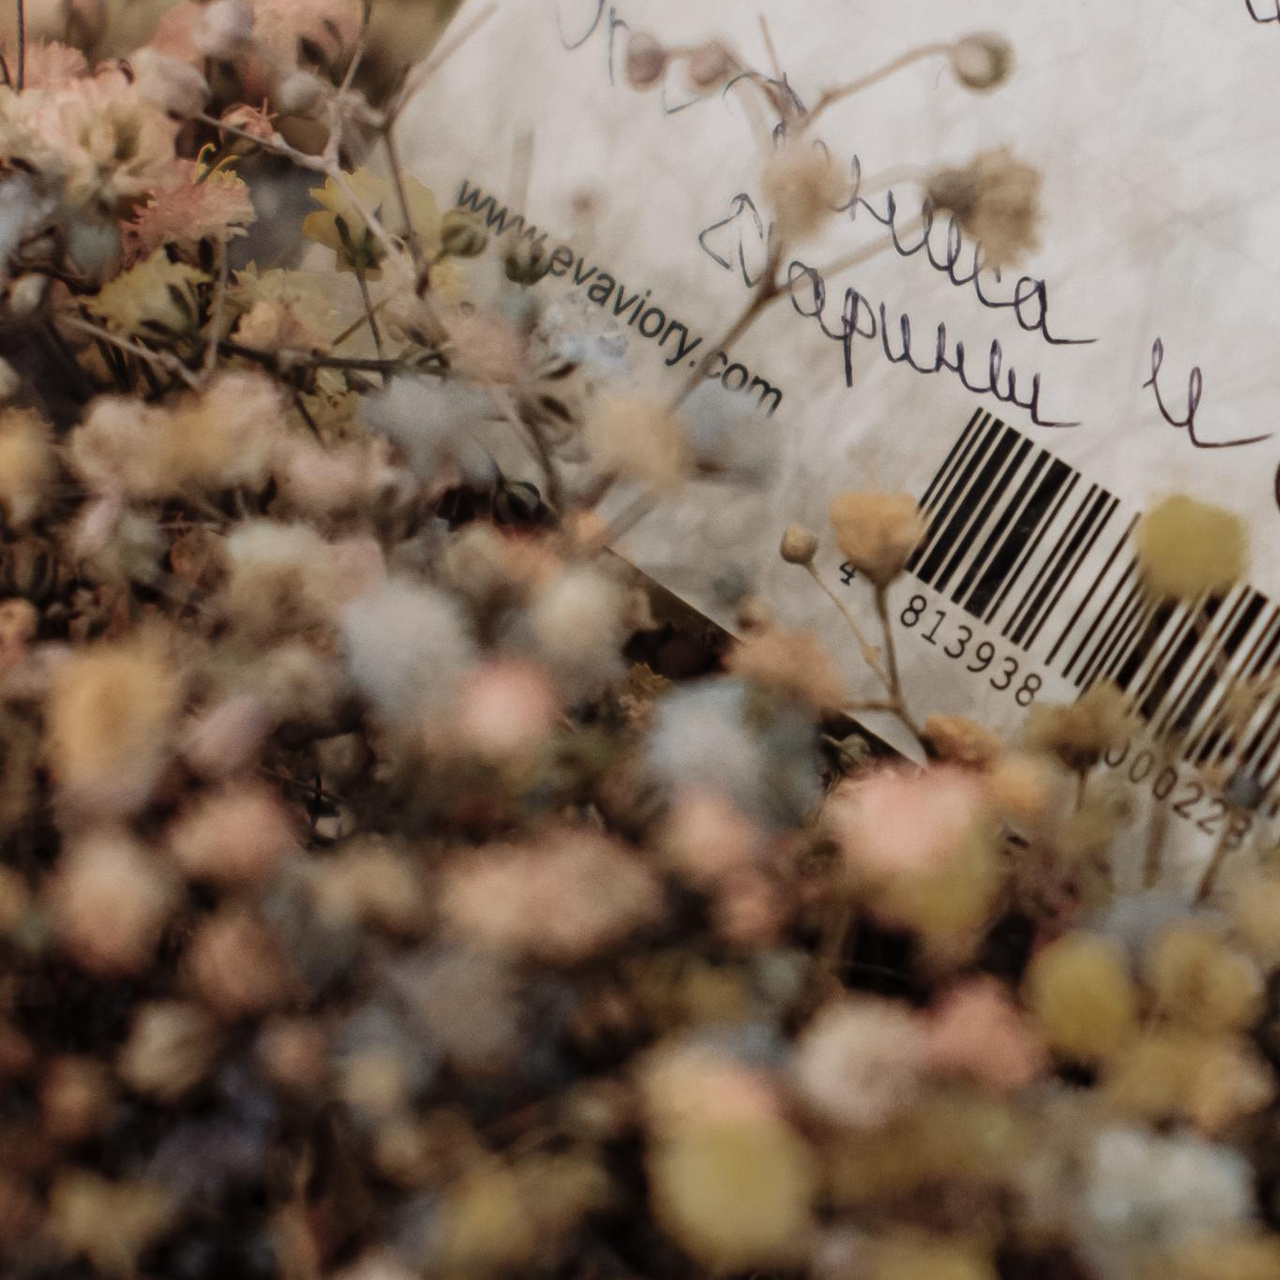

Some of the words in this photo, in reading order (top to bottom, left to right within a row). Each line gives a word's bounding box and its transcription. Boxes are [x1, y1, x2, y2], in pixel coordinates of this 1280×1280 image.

[456, 178, 784, 419] wwwevaviory.com
[1142, 335, 1274, 449] и
[839, 557, 859, 587] 4
[899, 593, 1044, 708] 813938
